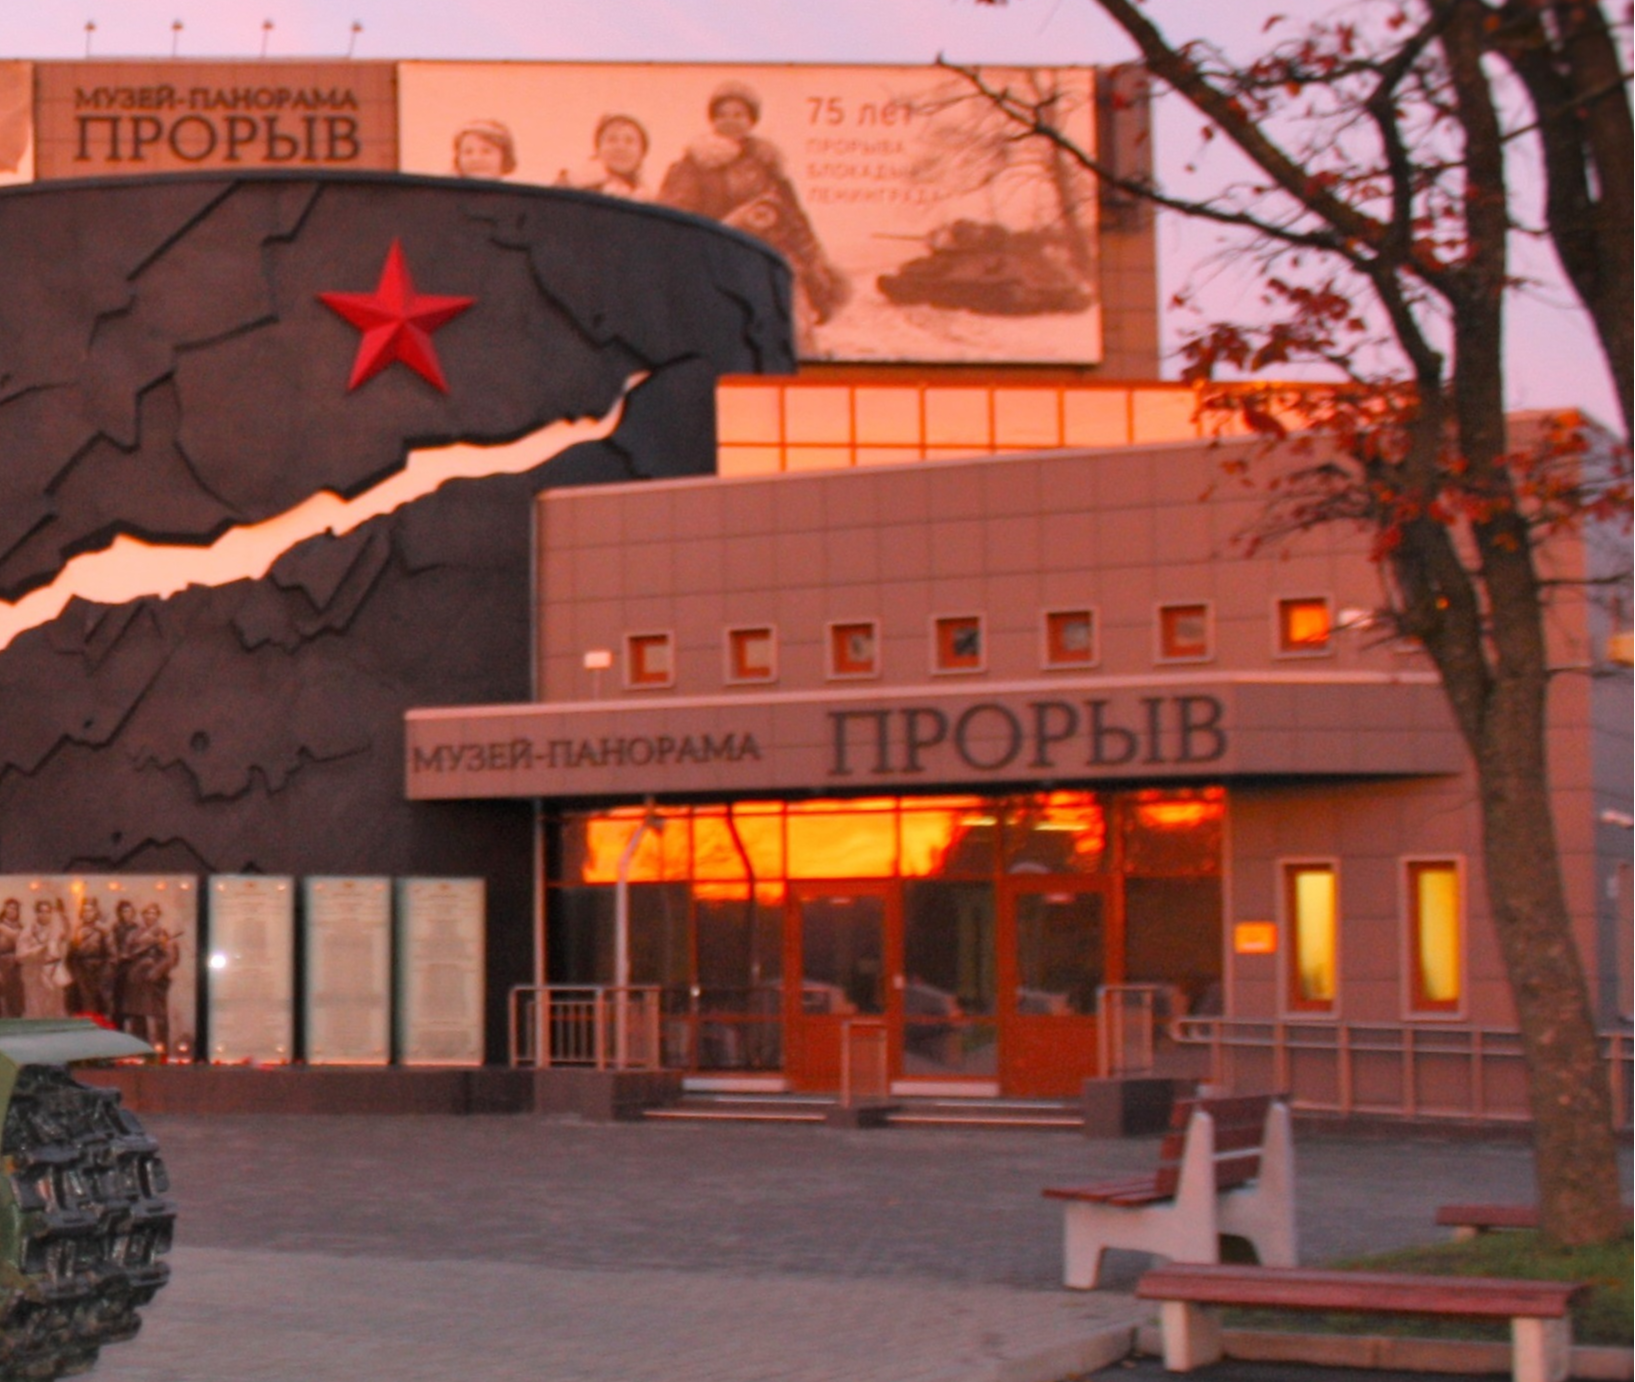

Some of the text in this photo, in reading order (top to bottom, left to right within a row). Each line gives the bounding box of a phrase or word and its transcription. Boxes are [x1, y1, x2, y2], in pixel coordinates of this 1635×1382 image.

[74, 85, 359, 110] МУЗЕЙ-ПАНОРАМА
[806, 97, 912, 127] 75 лет
[74, 114, 361, 162] ПРОРЫВ
[414, 695, 1228, 776] МУЗЕЙ-ПАНОРАМА ПРОРЫВ
